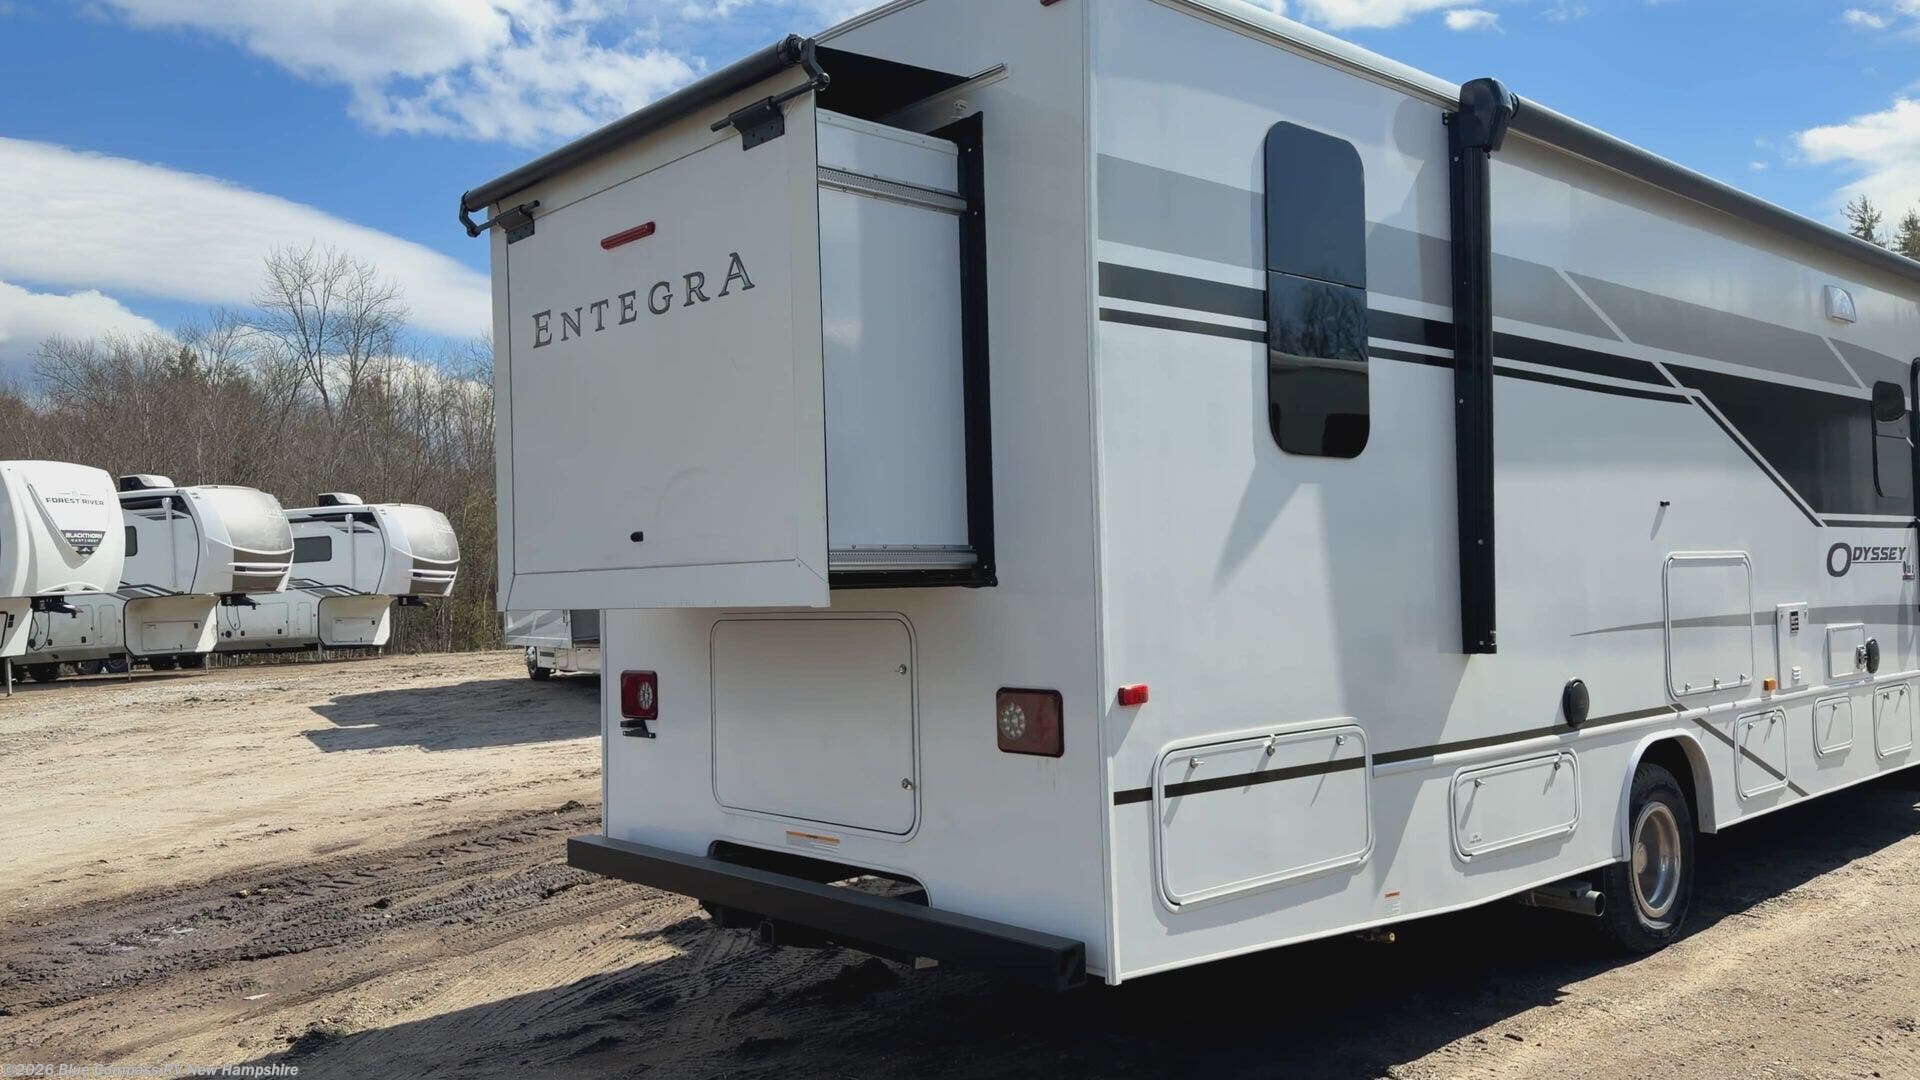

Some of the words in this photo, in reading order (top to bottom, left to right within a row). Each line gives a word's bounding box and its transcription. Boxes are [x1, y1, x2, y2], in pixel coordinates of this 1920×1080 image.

[532, 252, 755, 349] ENTEGRA
[82, 498, 104, 506] RIVER
[1826, 542, 1907, 578] ODYSSEY
